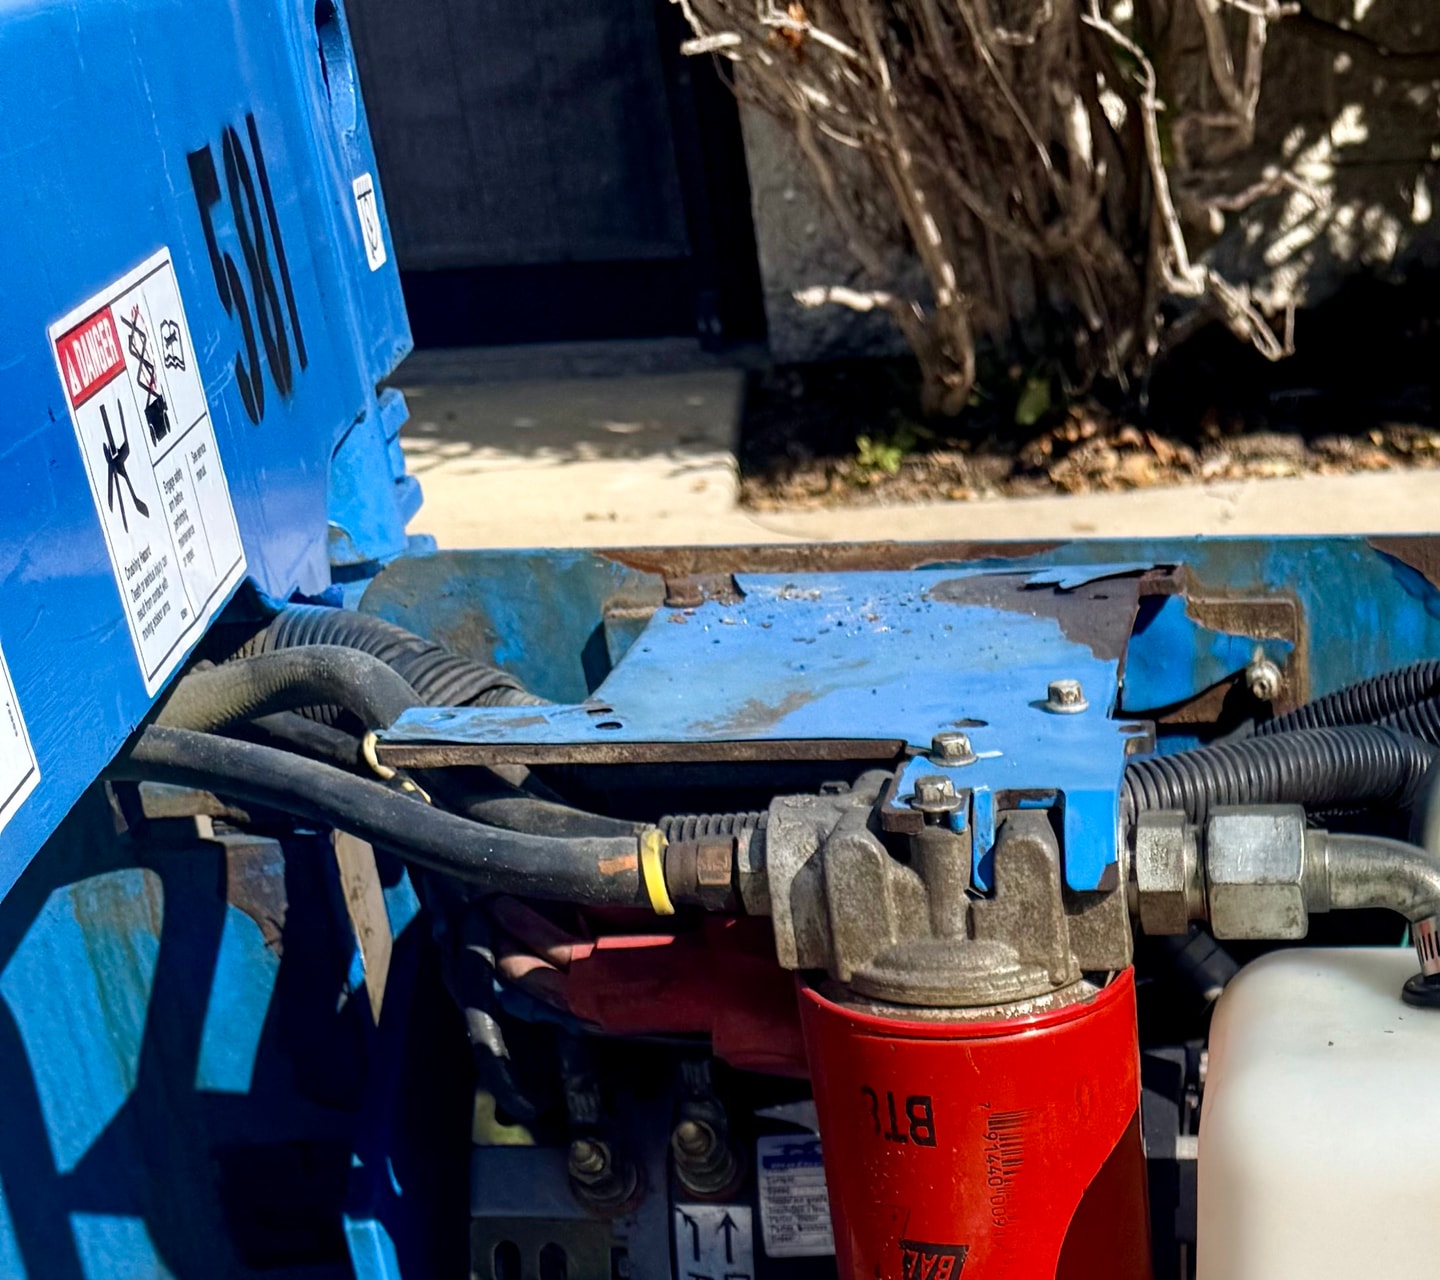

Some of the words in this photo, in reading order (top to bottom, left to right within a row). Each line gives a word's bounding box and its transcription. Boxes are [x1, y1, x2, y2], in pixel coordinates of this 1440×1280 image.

[187, 112, 308, 426] 581
[72, 317, 119, 388] DANGER
[983, 1131, 1004, 1187] 91440
